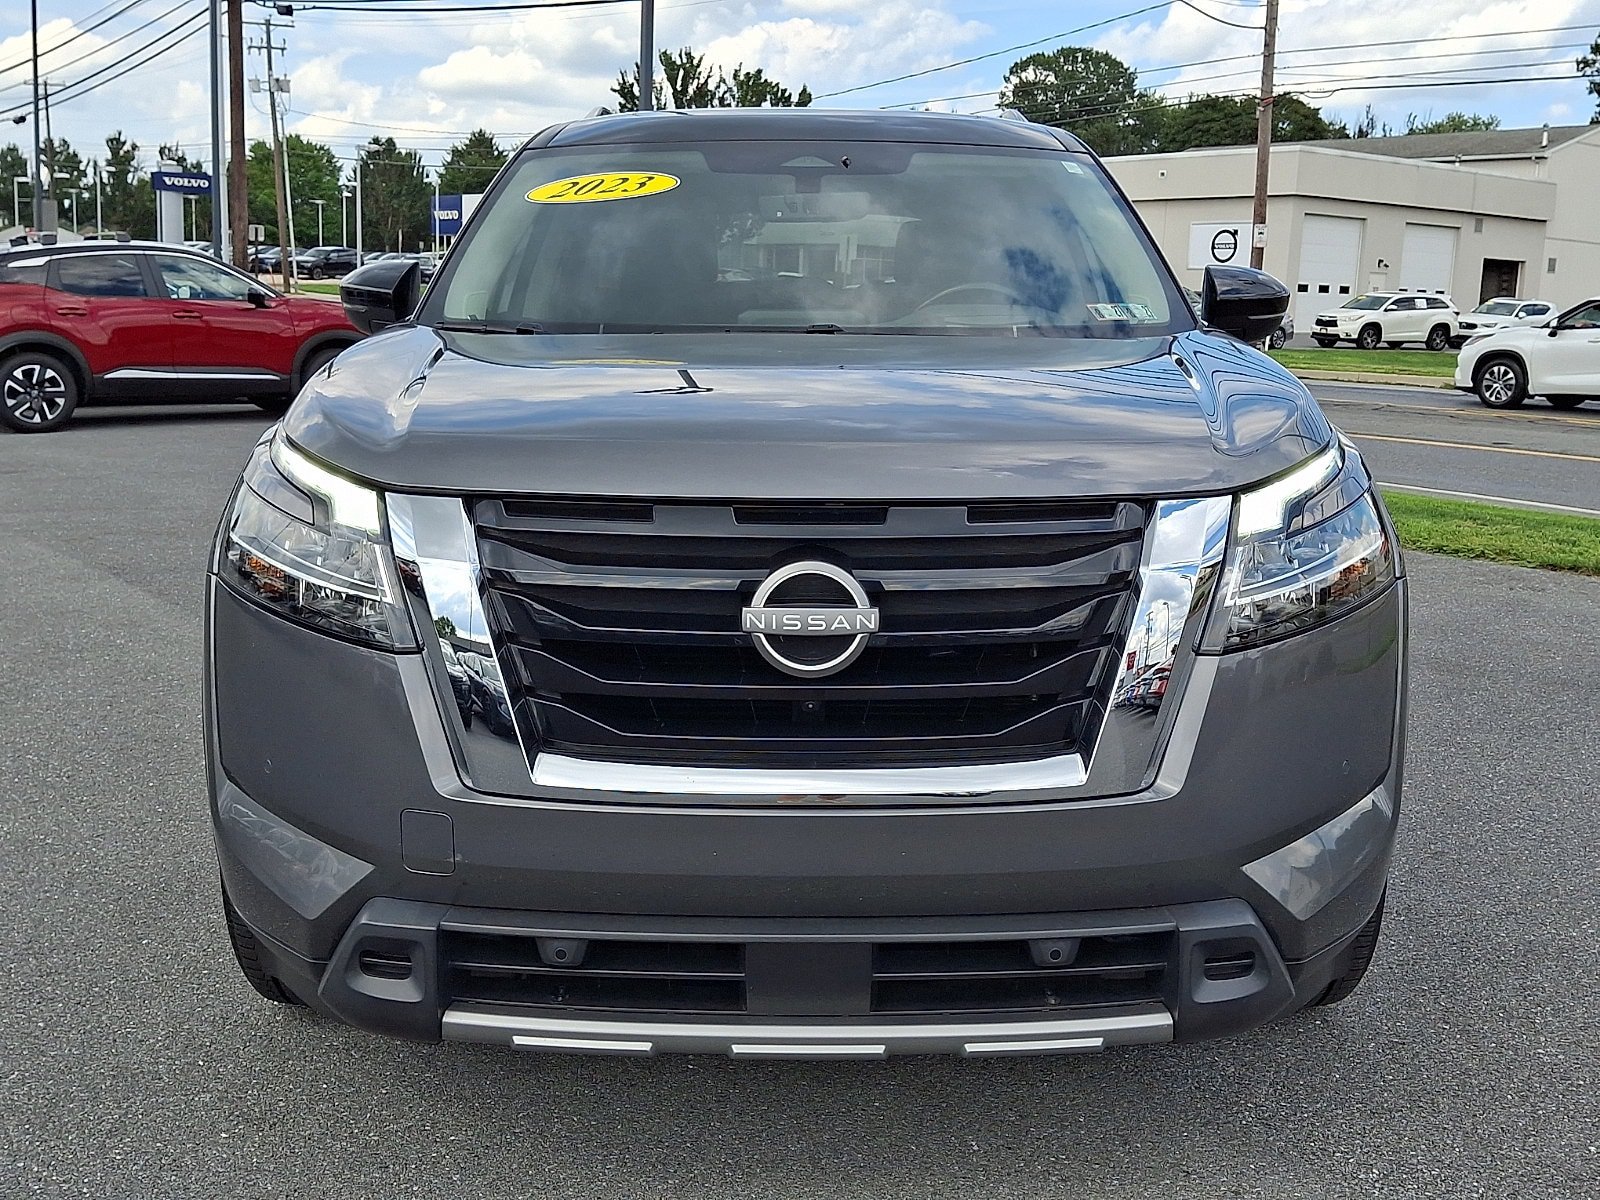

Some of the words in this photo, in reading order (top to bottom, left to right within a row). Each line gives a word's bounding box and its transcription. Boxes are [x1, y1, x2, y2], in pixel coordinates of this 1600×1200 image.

[162, 176, 210, 188] VOLVO
[545, 176, 656, 200] 2023
[433, 210, 459, 220] VOLVO
[746, 613, 876, 631] NISSAN
